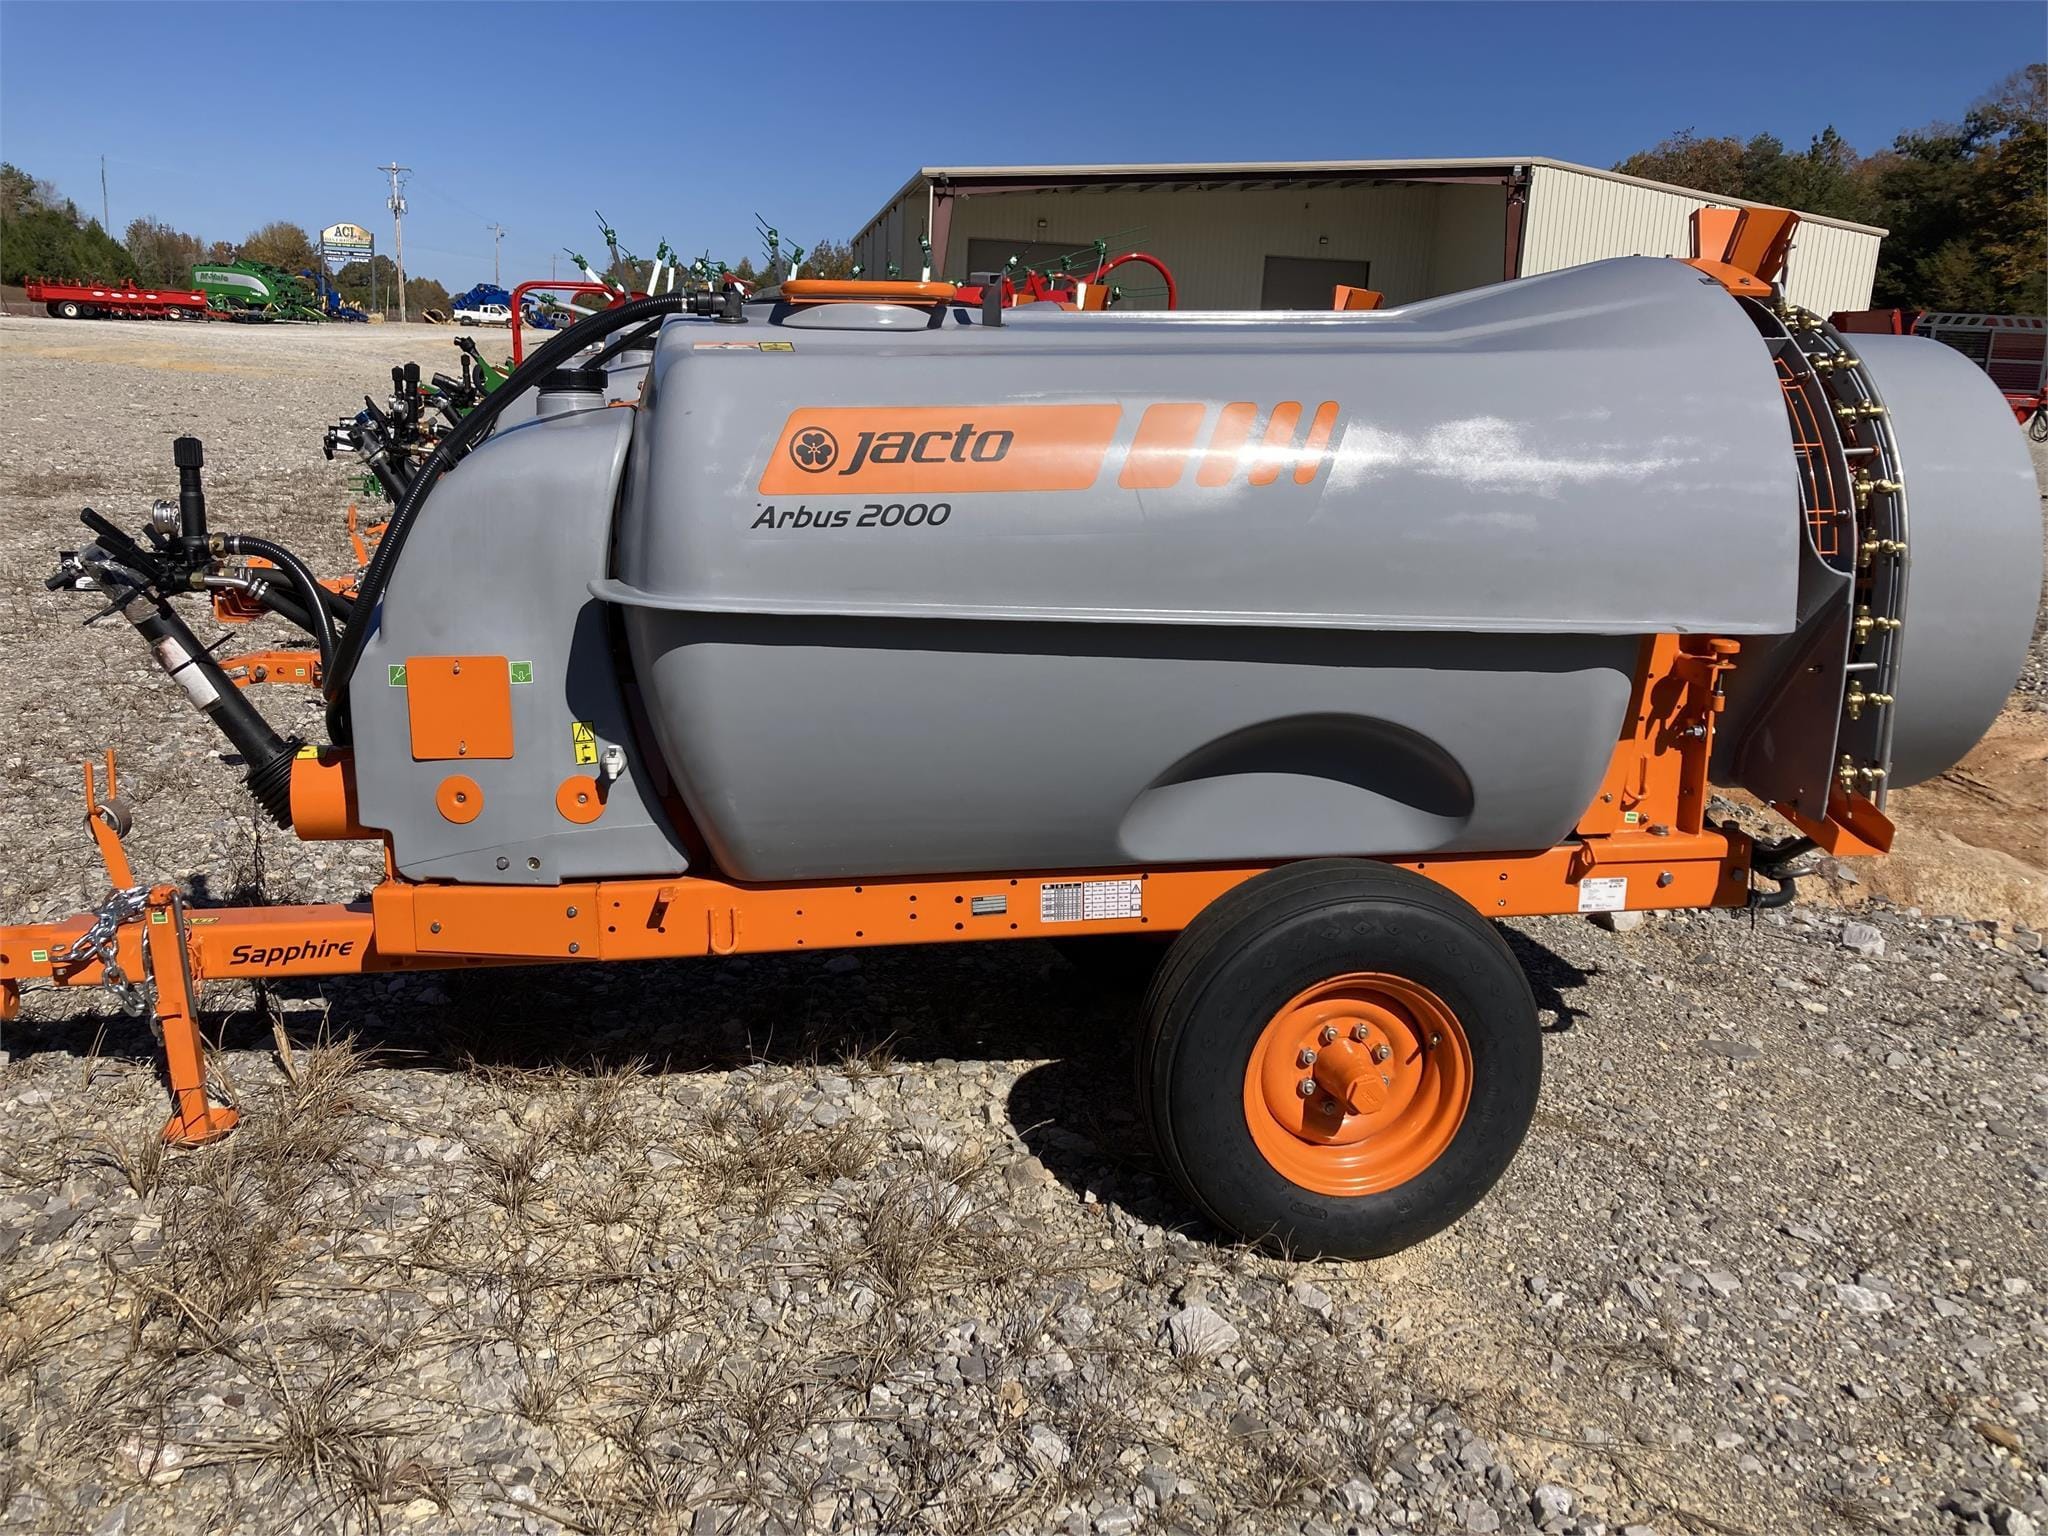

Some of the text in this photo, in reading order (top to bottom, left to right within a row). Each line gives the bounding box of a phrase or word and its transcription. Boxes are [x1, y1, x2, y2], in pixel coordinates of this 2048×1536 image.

[751, 503, 952, 529] Arbus 2000
[229, 939, 354, 967] Sapphire
